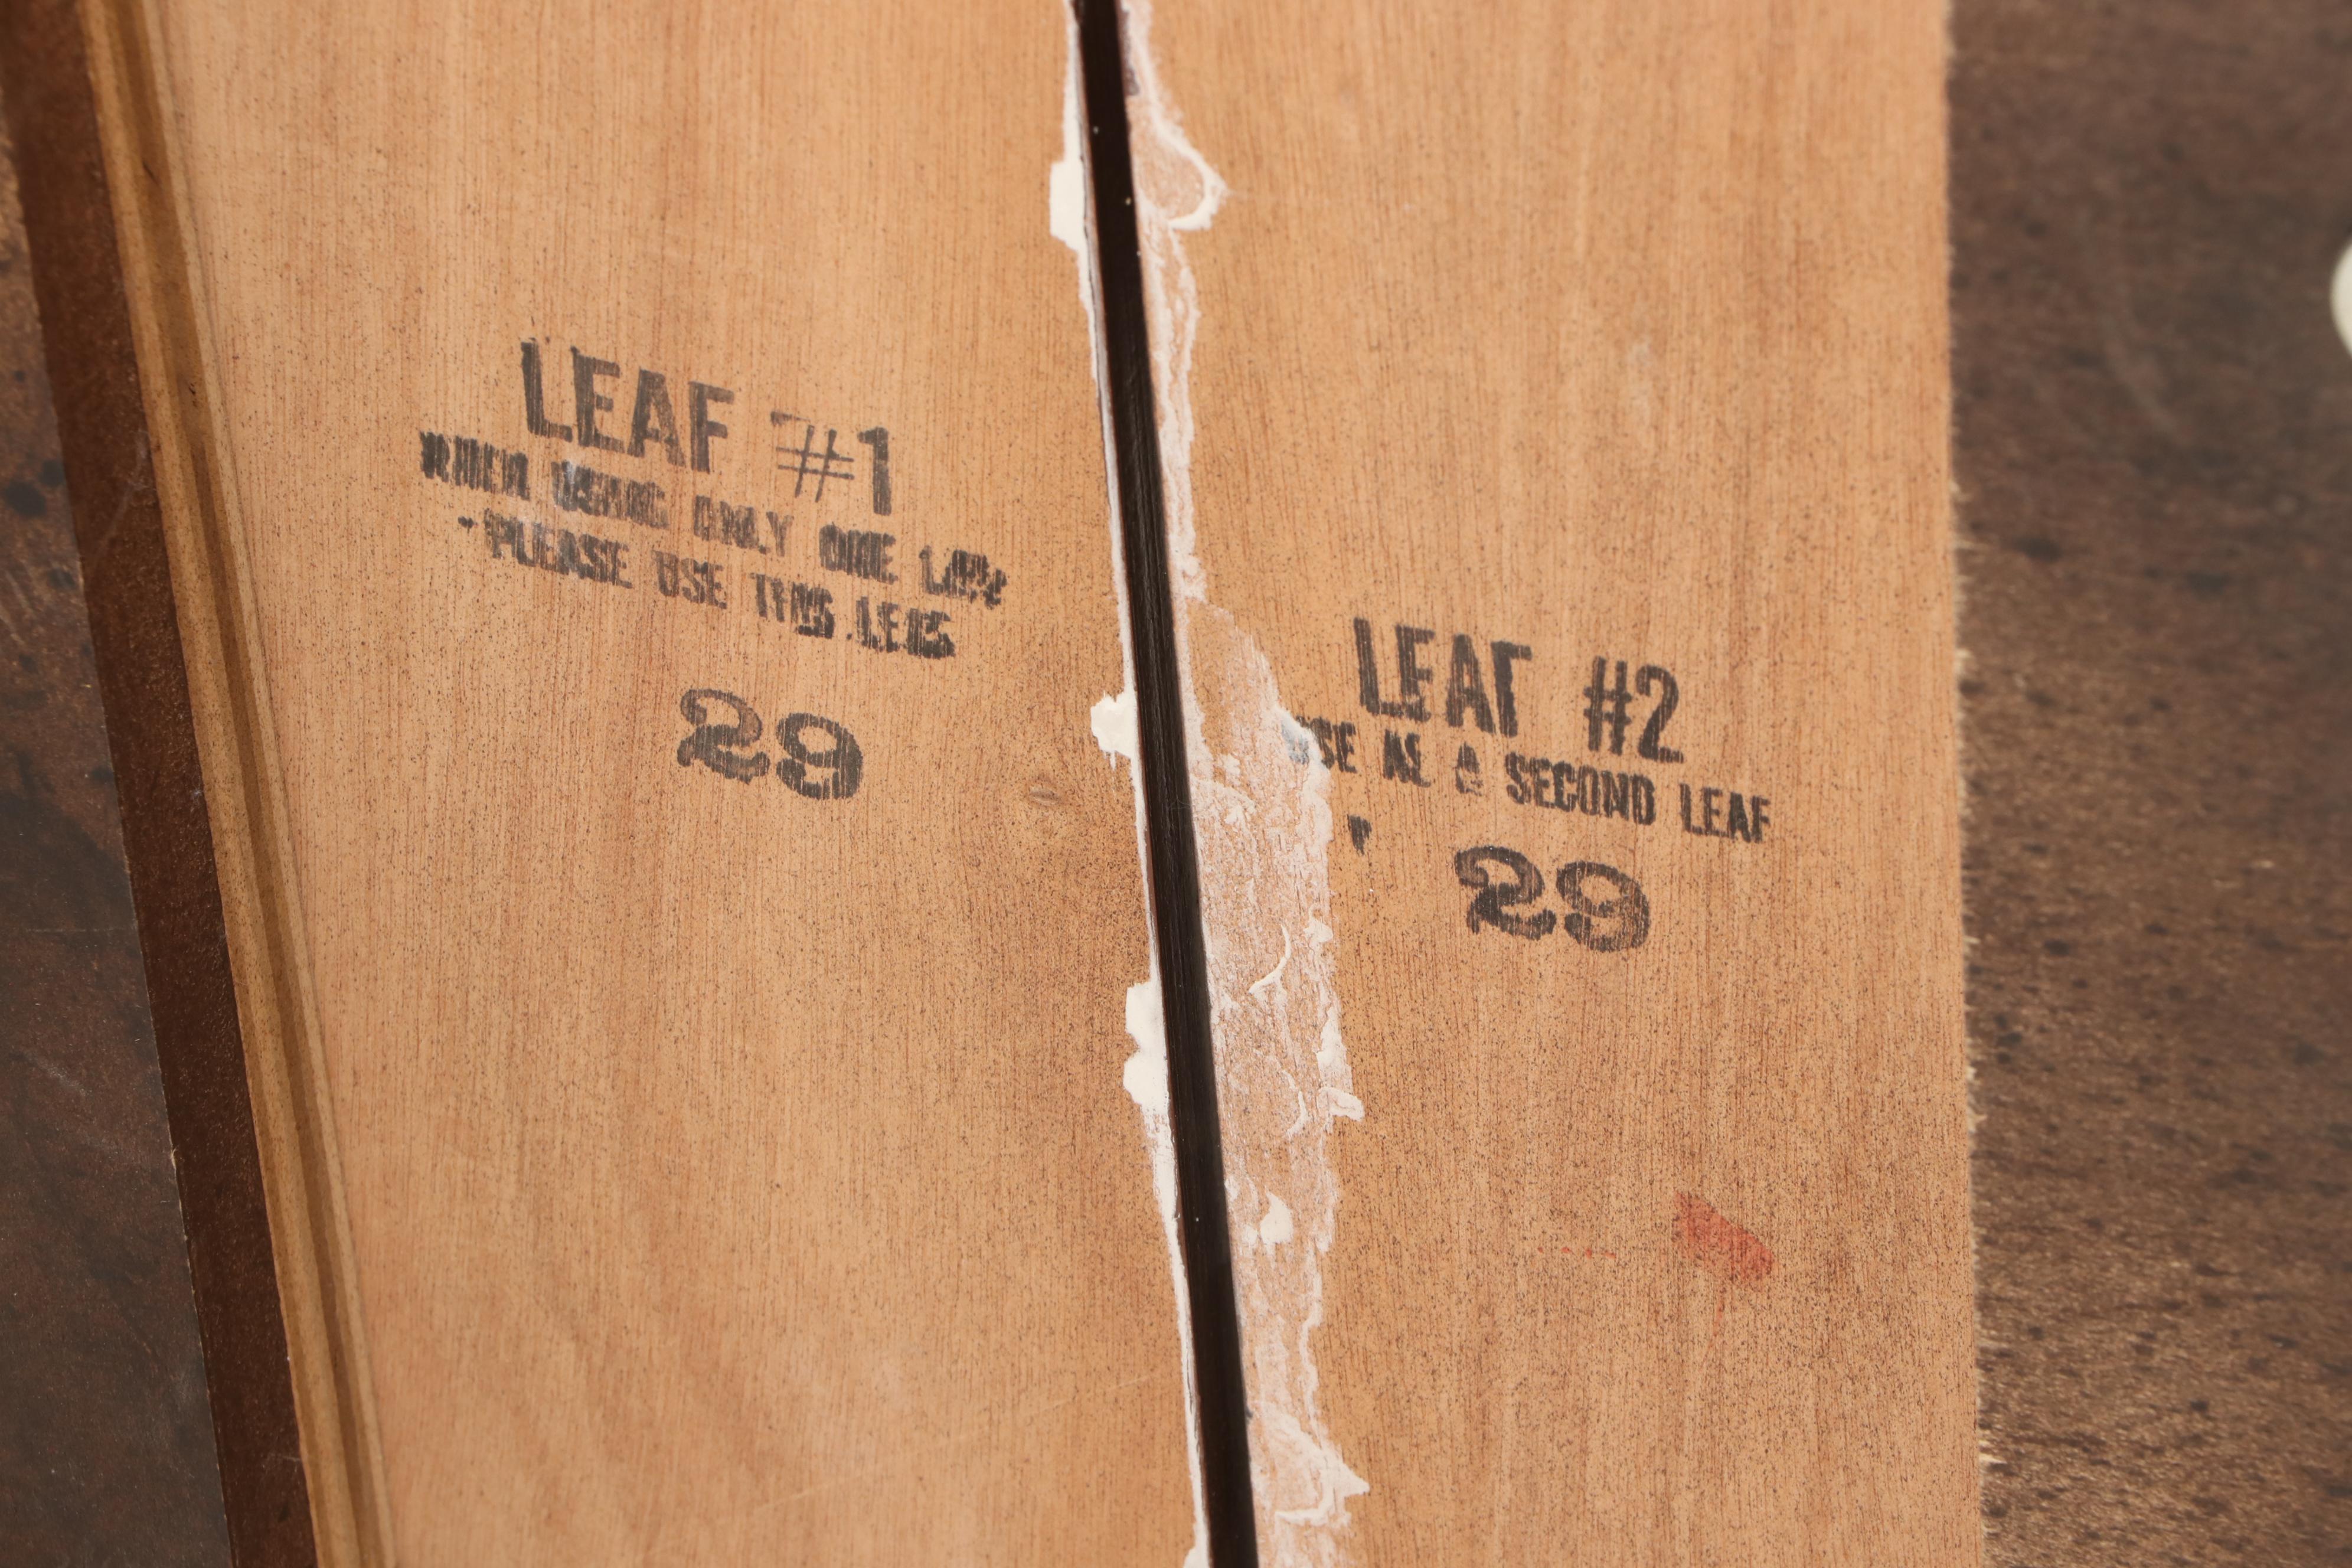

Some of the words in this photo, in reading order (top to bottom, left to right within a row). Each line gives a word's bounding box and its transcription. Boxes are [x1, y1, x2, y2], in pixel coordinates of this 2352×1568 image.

[521, 338, 734, 474] LEAF
[776, 424, 892, 516] #1
[484, 508, 633, 589] PLEASE
[651, 549, 727, 609] USE
[677, 688, 863, 800] 29
[1583, 655, 1685, 764] #2
[1504, 751, 1656, 826] SECOND
[1678, 782, 1772, 844] LEAF
[1454, 845, 1651, 953] 29
